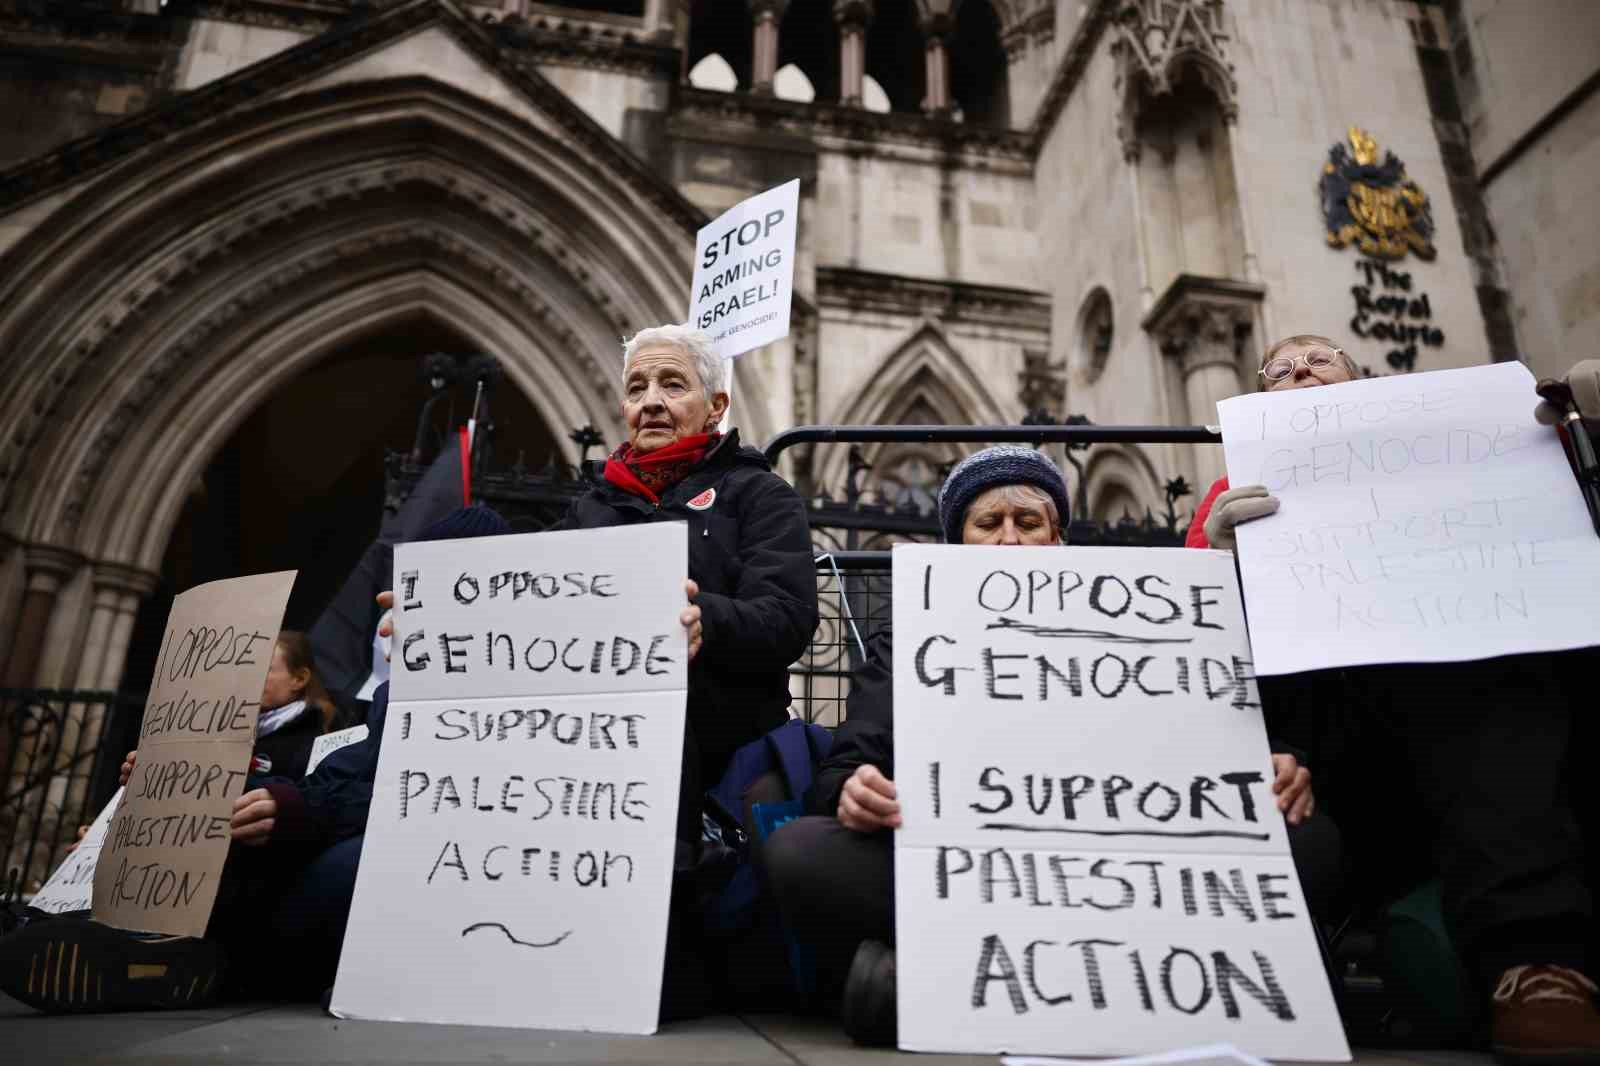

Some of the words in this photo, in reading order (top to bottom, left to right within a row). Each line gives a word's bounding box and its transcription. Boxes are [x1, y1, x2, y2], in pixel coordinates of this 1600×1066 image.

[702, 209, 785, 270] STOP
[699, 249, 782, 303] ARMING
[697, 279, 778, 329] ISRAEL!
[728, 311, 778, 336] GENOCIDE!
[1289, 391, 1455, 436] OPPOSE
[1264, 424, 1526, 491] GENOCIDE
[402, 569, 422, 611] I
[453, 570, 619, 604] OPPOSE
[923, 564, 932, 610] I
[978, 569, 1225, 630] OPPOSE
[157, 629, 175, 688] I
[169, 625, 271, 682] OPPOSE
[915, 635, 1261, 710] GENOCIDE
[142, 690, 260, 738] GENOCIDE
[401, 711, 412, 740] I
[435, 708, 646, 750] SUPPORT
[137, 760, 246, 800] SUPPORT
[929, 761, 940, 818] I
[969, 767, 1265, 823] SUPPORT
[112, 814, 231, 853] PALESTINE
[110, 856, 206, 910] ACTION
[935, 846, 1296, 923] PALESTINE
[971, 934, 1297, 1020] ACTION
